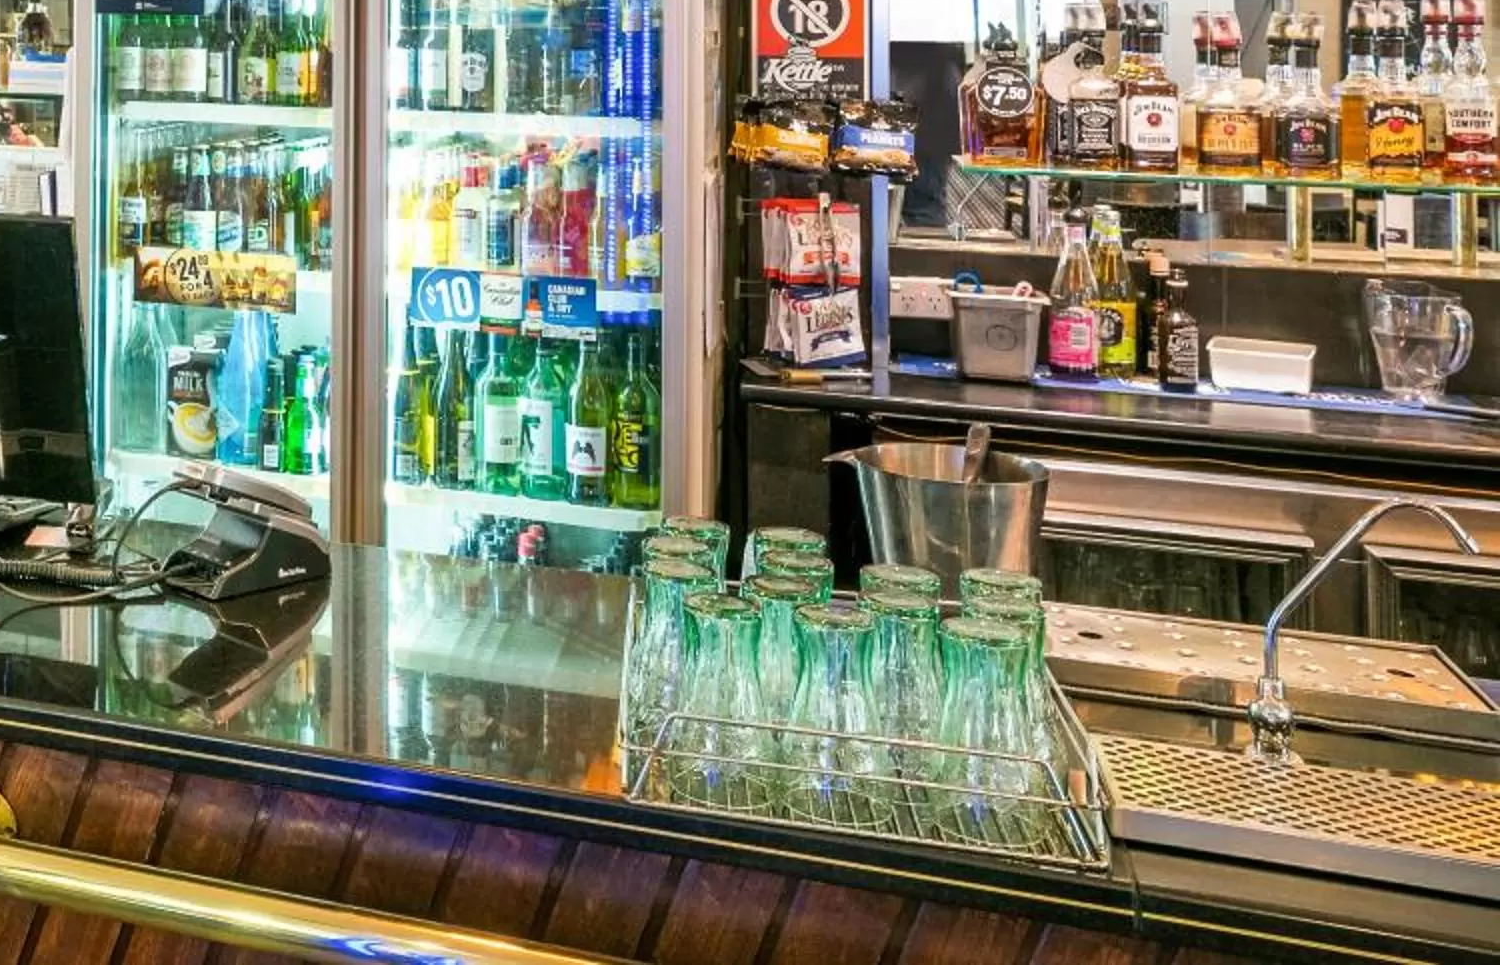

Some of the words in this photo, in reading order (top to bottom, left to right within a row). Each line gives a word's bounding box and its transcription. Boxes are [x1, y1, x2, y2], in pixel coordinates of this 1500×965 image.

[788, 1, 828, 33] 18
[983, 85, 1027, 106] $7.50
[425, 276, 475, 318] $10
[173, 376, 205, 392] MILK
